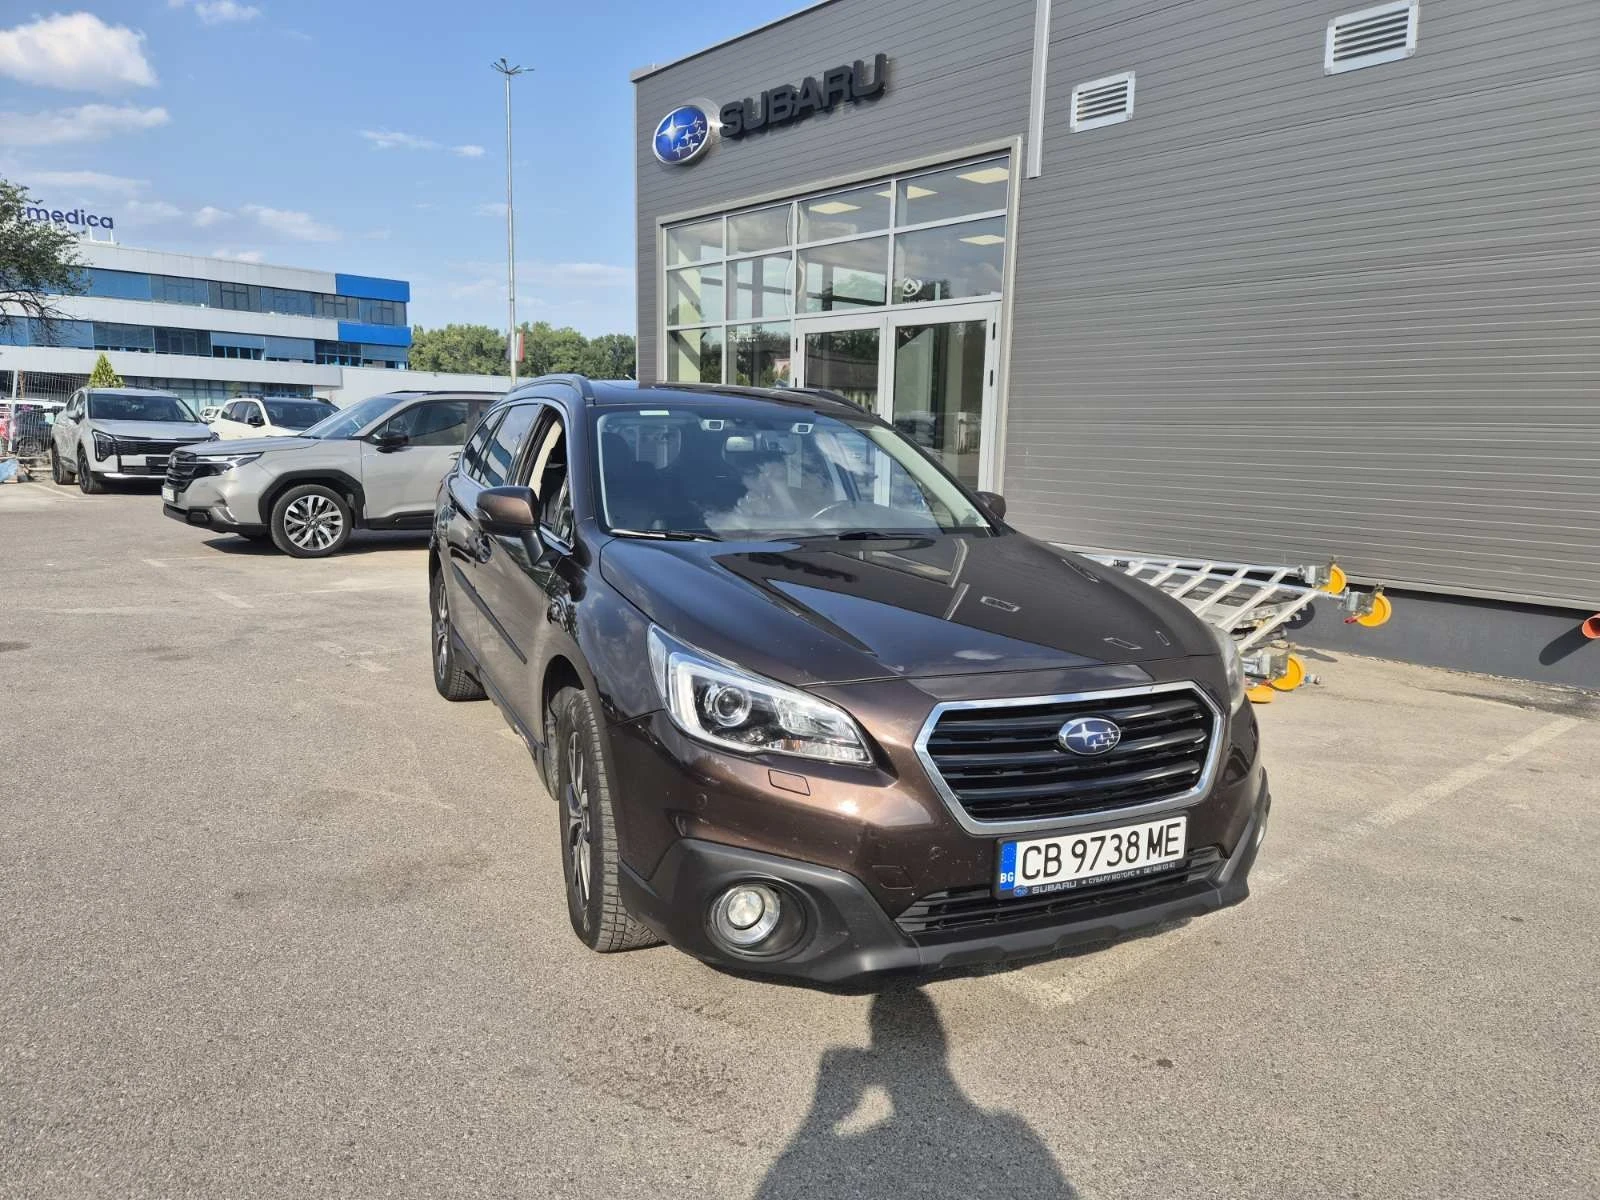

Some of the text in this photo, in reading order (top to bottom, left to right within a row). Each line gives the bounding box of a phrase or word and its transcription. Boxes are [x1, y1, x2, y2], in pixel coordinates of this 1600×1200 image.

[719, 53, 887, 138] SUBARU
[17, 206, 114, 229] medica
[1021, 822, 1182, 880] CB 9738 ME
[1000, 872, 1014, 884] BG
[1031, 880, 1077, 895] SUBARU
